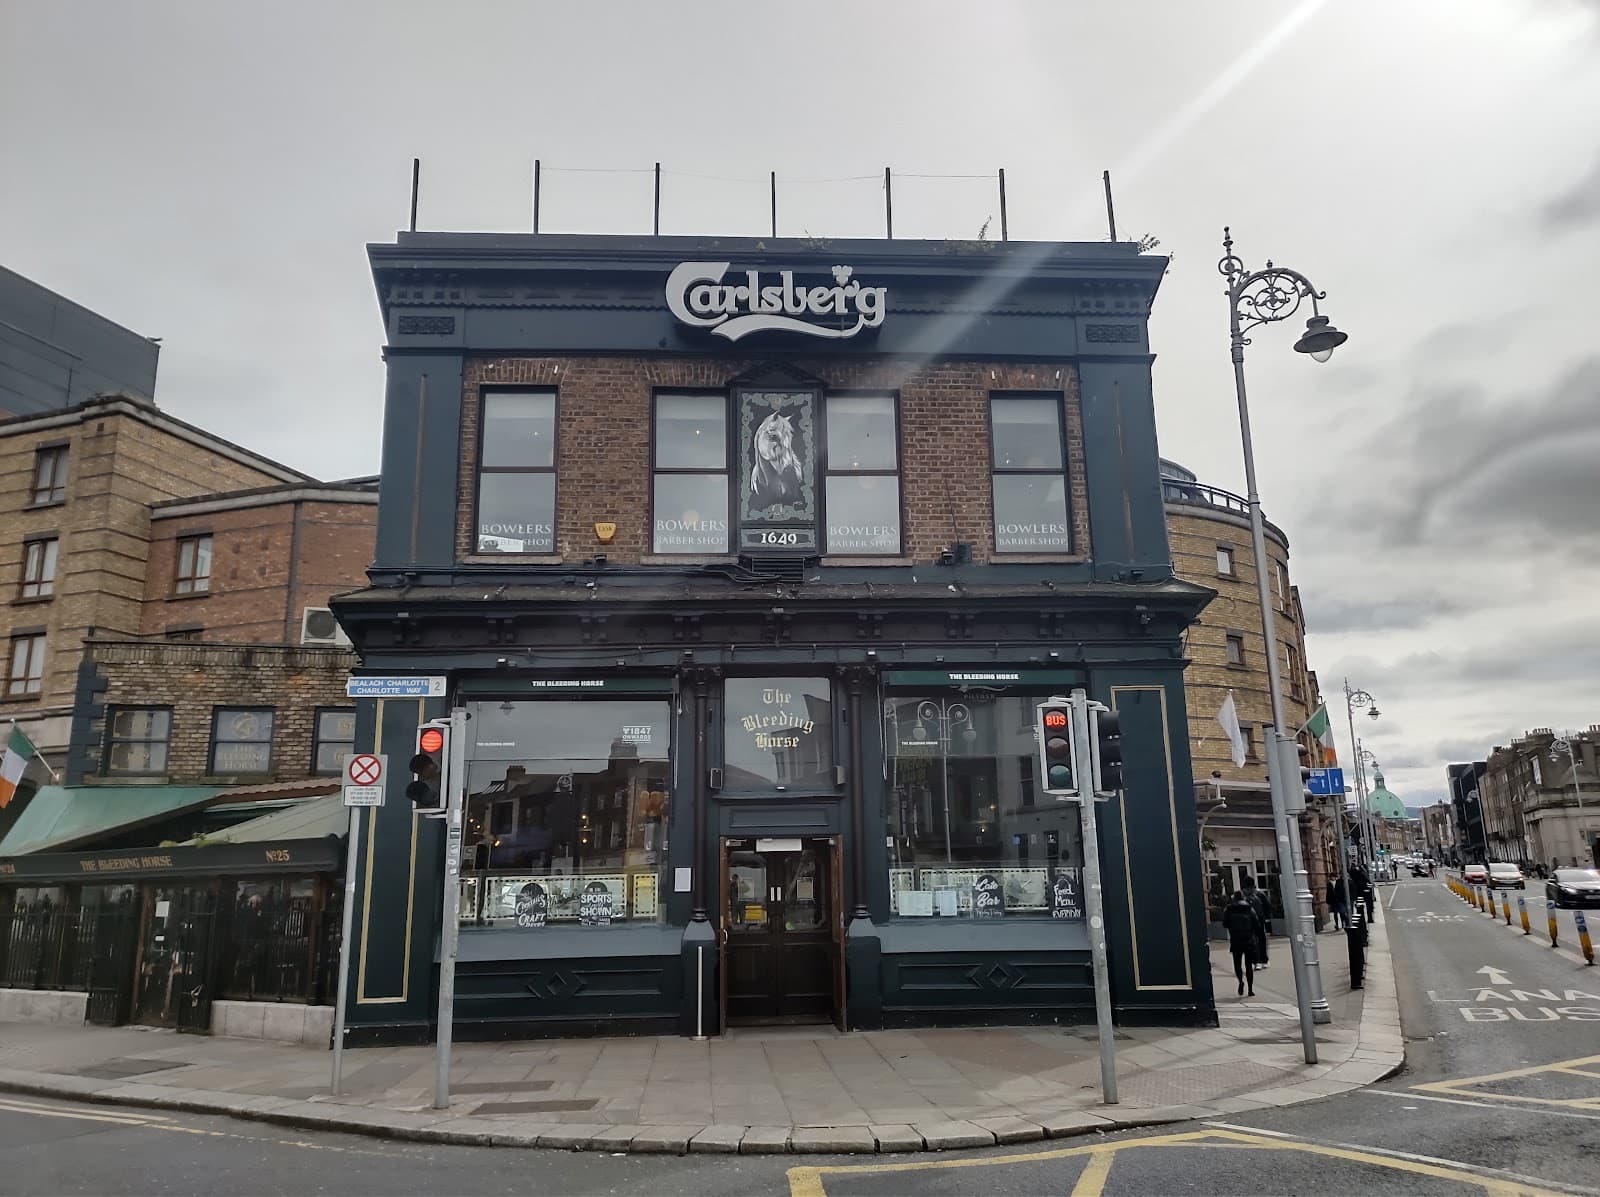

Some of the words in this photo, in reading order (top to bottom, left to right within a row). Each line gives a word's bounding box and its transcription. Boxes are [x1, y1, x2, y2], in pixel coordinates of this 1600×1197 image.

[665, 261, 888, 328] Carlsberg
[481, 523, 552, 534] BOWLERS
[655, 519, 727, 531] BOWLERS
[829, 525, 897, 536] BOWLERS
[998, 523, 1066, 534] BOWLERS
[656, 535, 700, 545] BARBER
[700, 535, 724, 545] SHOP
[760, 532, 798, 545] 1649
[999, 537, 1037, 546] BARBER
[1038, 537, 1066, 546] SHOP
[386, 679, 429, 687] CHARLOTTE
[434, 681, 442, 691] 2
[762, 687, 792, 708] The
[741, 710, 815, 735] Bleeding
[1045, 715, 1067, 726] BUS
[630, 727, 652, 735] 1847
[755, 732, 800, 752] Horse
[80, 860, 96, 871] THE
[141, 855, 173, 868] HORSE
[975, 878, 999, 892] Late
[580, 893, 612, 904] SPORTS
[976, 892, 1001, 907] Bar
[580, 906, 612, 917] SHOWN
[518, 912, 546, 926] CRAFT
[1459, 1006, 1600, 1022] BUS
